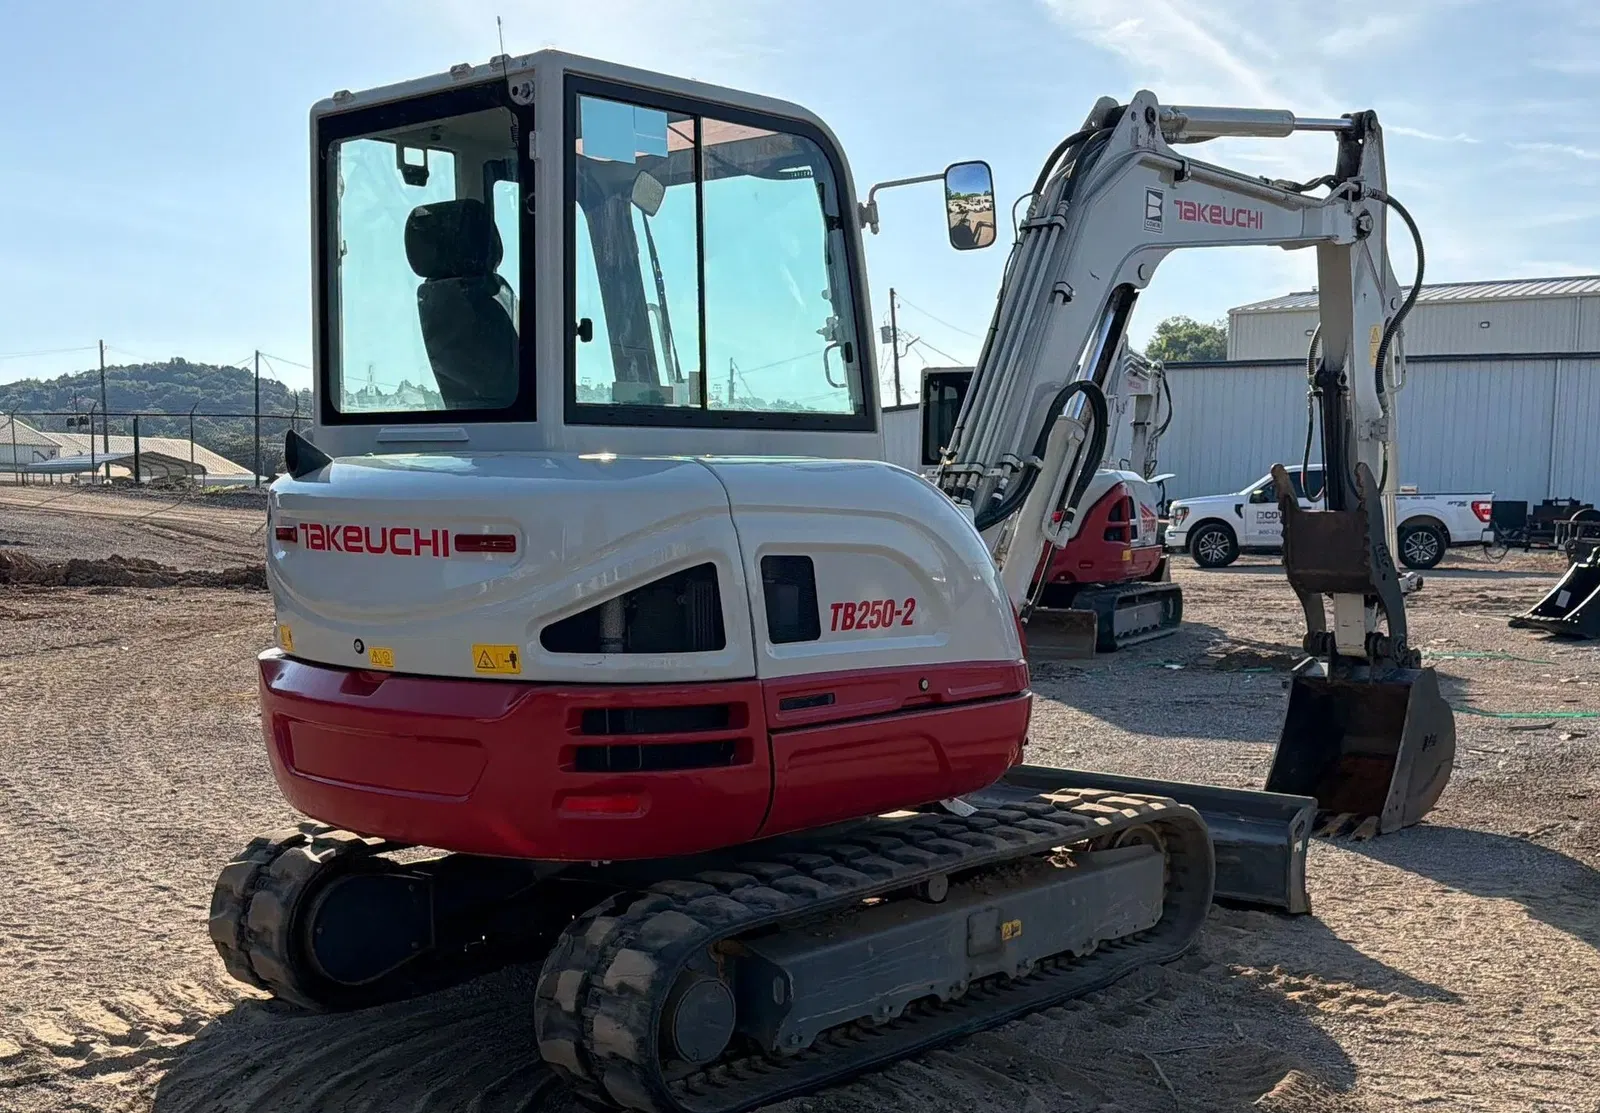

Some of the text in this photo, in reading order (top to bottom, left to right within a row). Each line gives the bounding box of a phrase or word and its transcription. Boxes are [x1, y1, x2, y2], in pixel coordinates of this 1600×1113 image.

[1174, 199, 1263, 230] TAKEUCHI
[299, 523, 450, 557] TAKEUCHI
[830, 597, 916, 632] TB250-2
